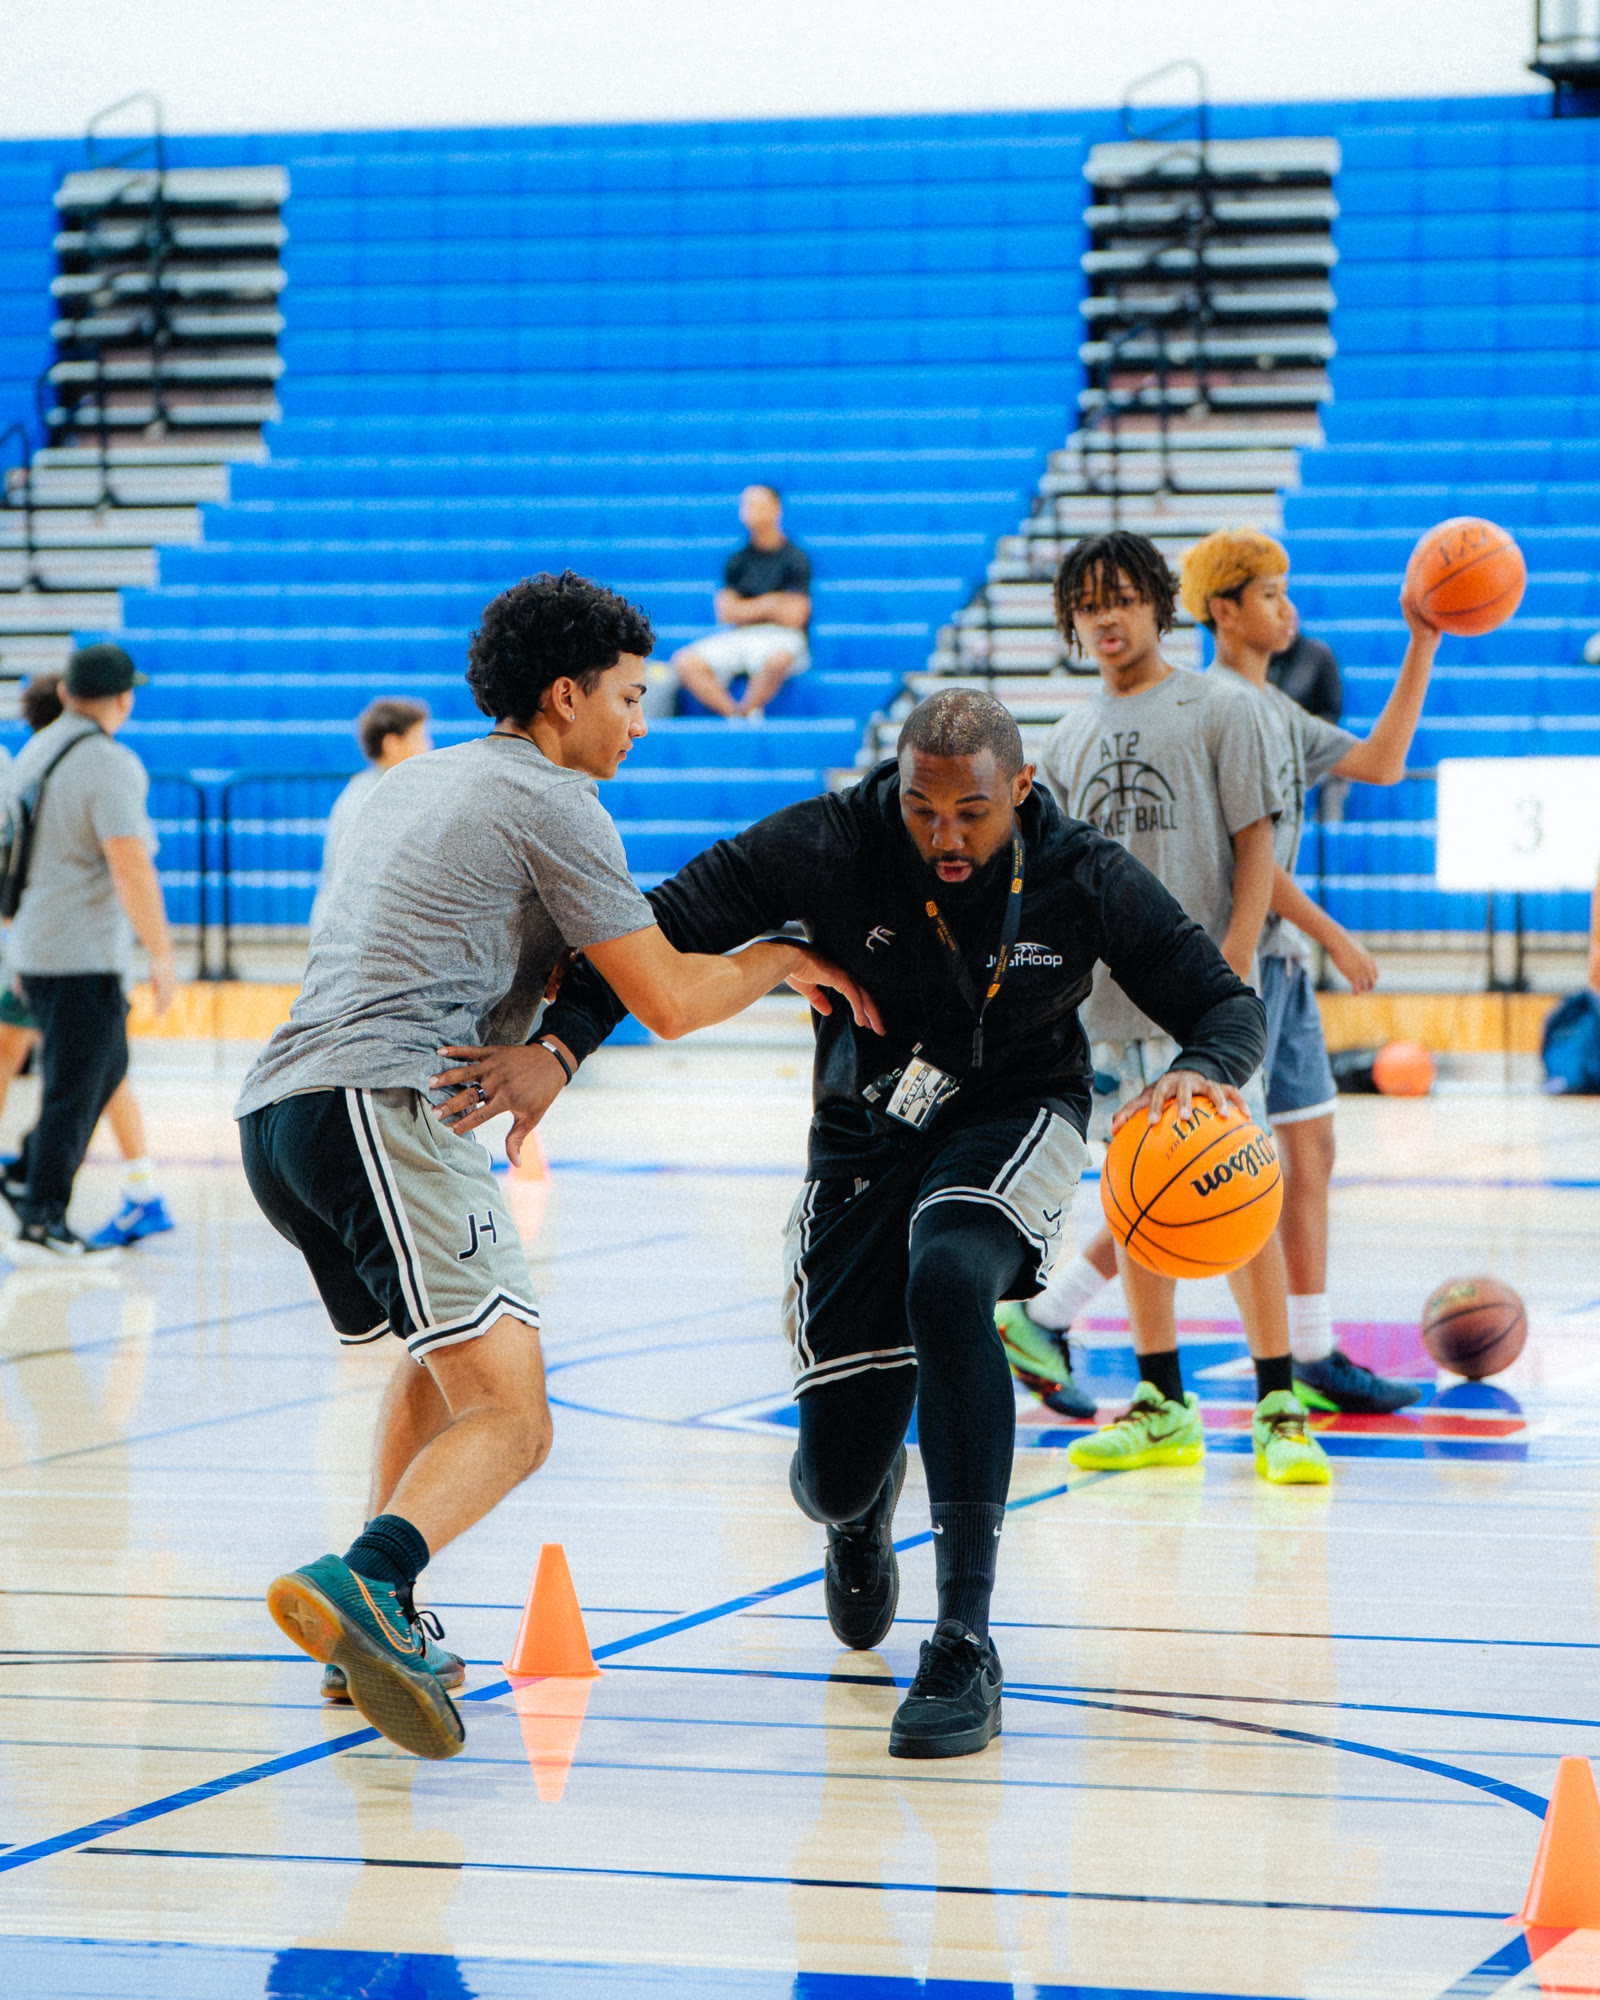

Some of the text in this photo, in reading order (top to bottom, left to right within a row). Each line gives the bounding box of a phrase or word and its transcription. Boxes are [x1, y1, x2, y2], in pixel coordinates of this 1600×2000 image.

[1101, 730, 1140, 762] AT2
[1087, 803, 1178, 837] KETBALL
[1513, 796, 1544, 854] 3
[985, 952, 1063, 968] JstHoop
[902, 1069, 928, 1113] STAFF
[1190, 1133, 1277, 1197] Wilson
